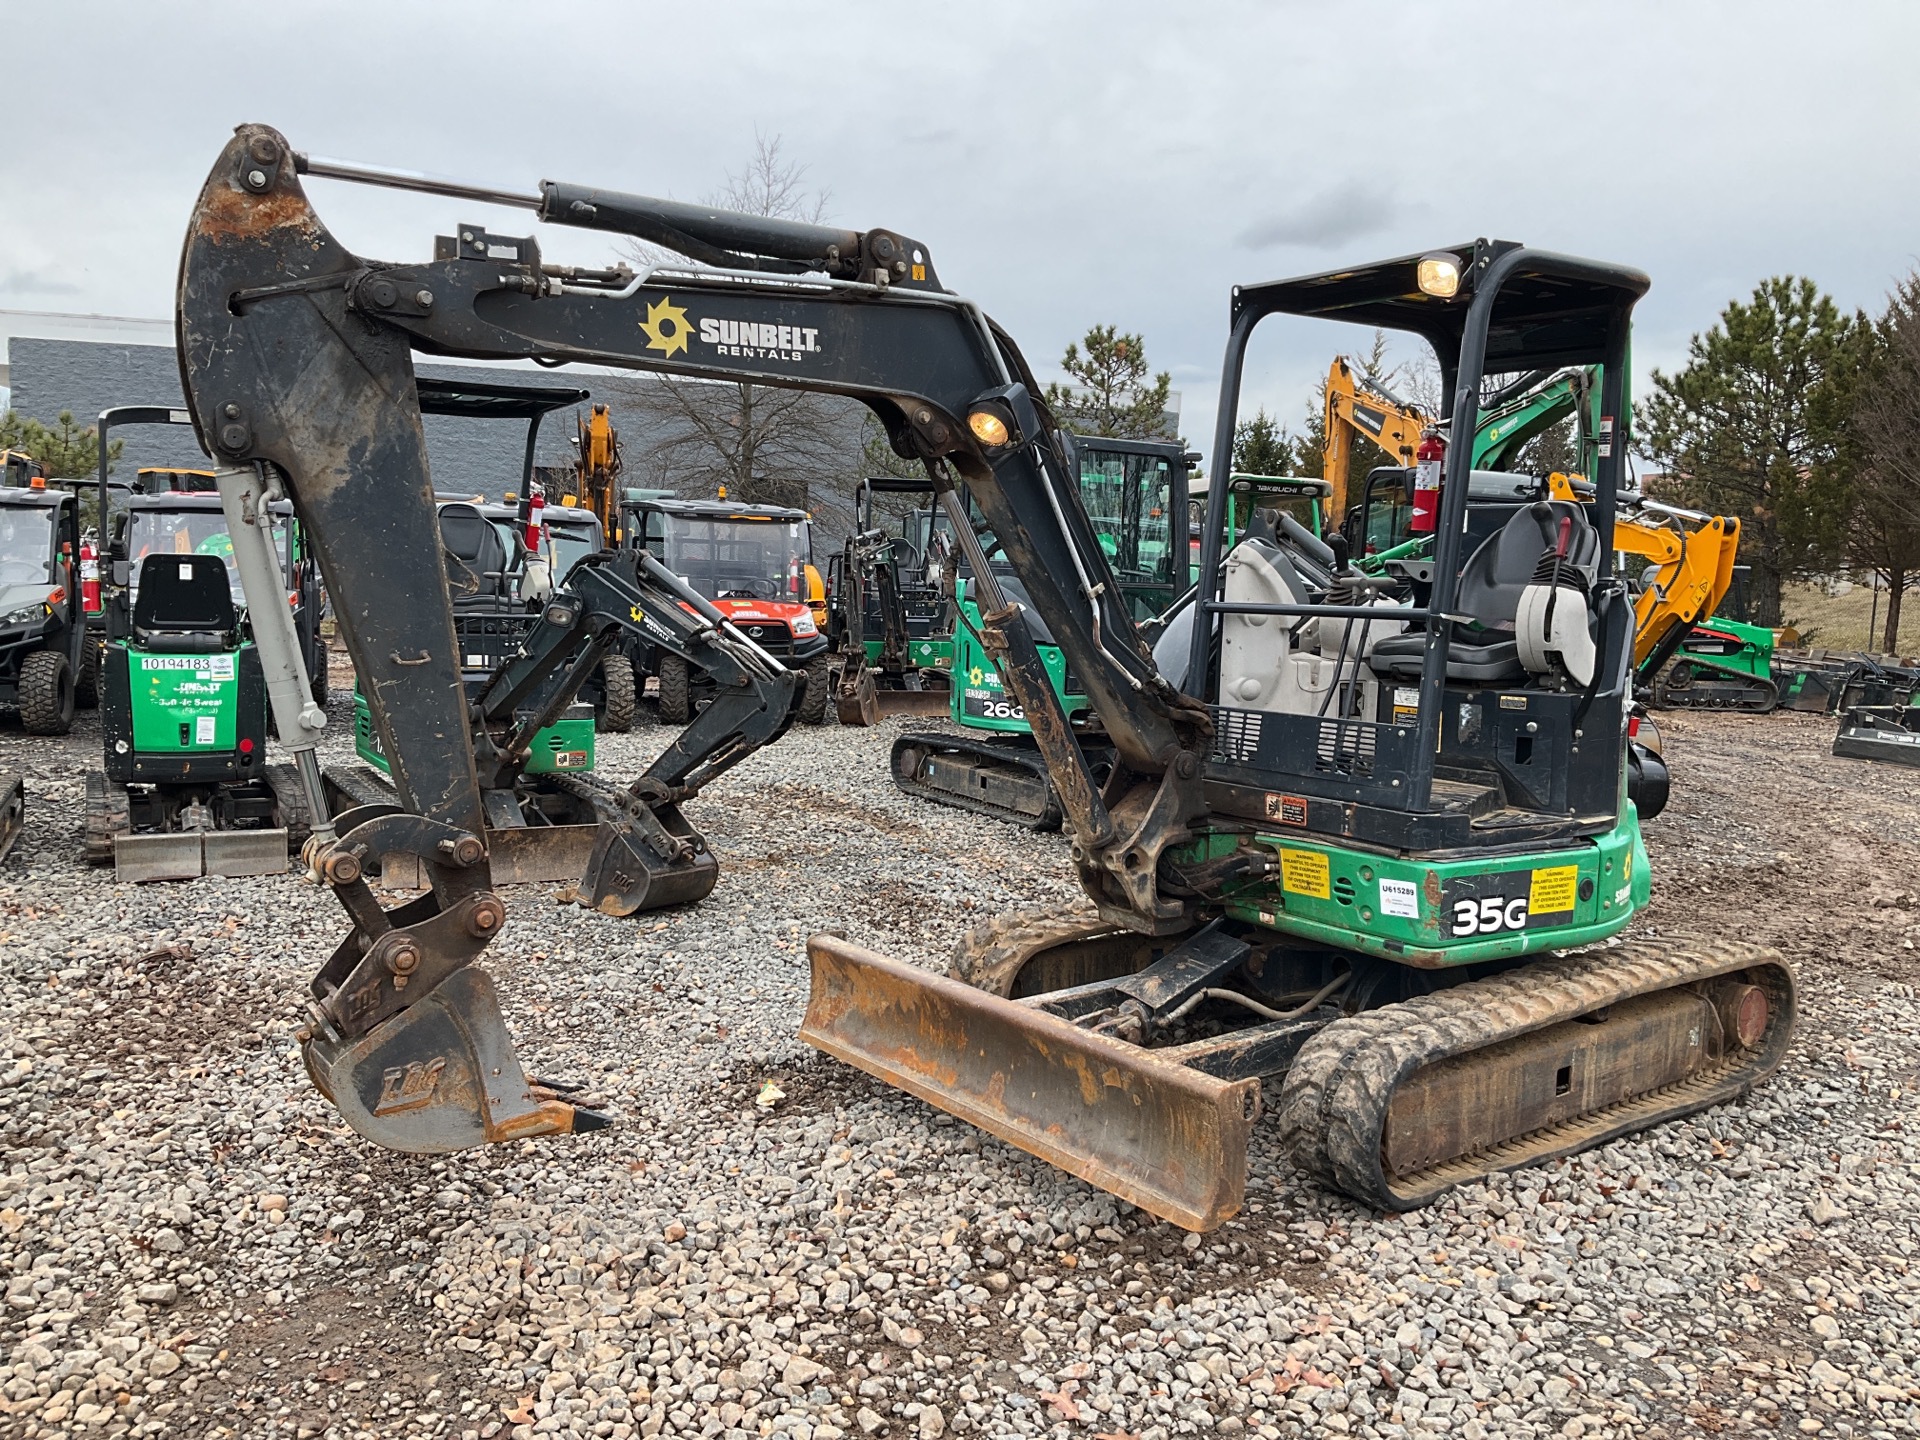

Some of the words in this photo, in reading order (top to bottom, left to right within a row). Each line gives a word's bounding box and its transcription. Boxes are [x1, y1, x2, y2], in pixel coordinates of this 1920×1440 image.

[700, 318, 818, 352] SUNBELT
[717, 345, 802, 361] RENTALS
[1257, 485, 1298, 494] TAKEUCHI
[144, 659, 210, 669] 10194183
[983, 701, 1024, 719] 26G
[1382, 885, 1414, 896] U615289
[1452, 897, 1527, 936] 35G
